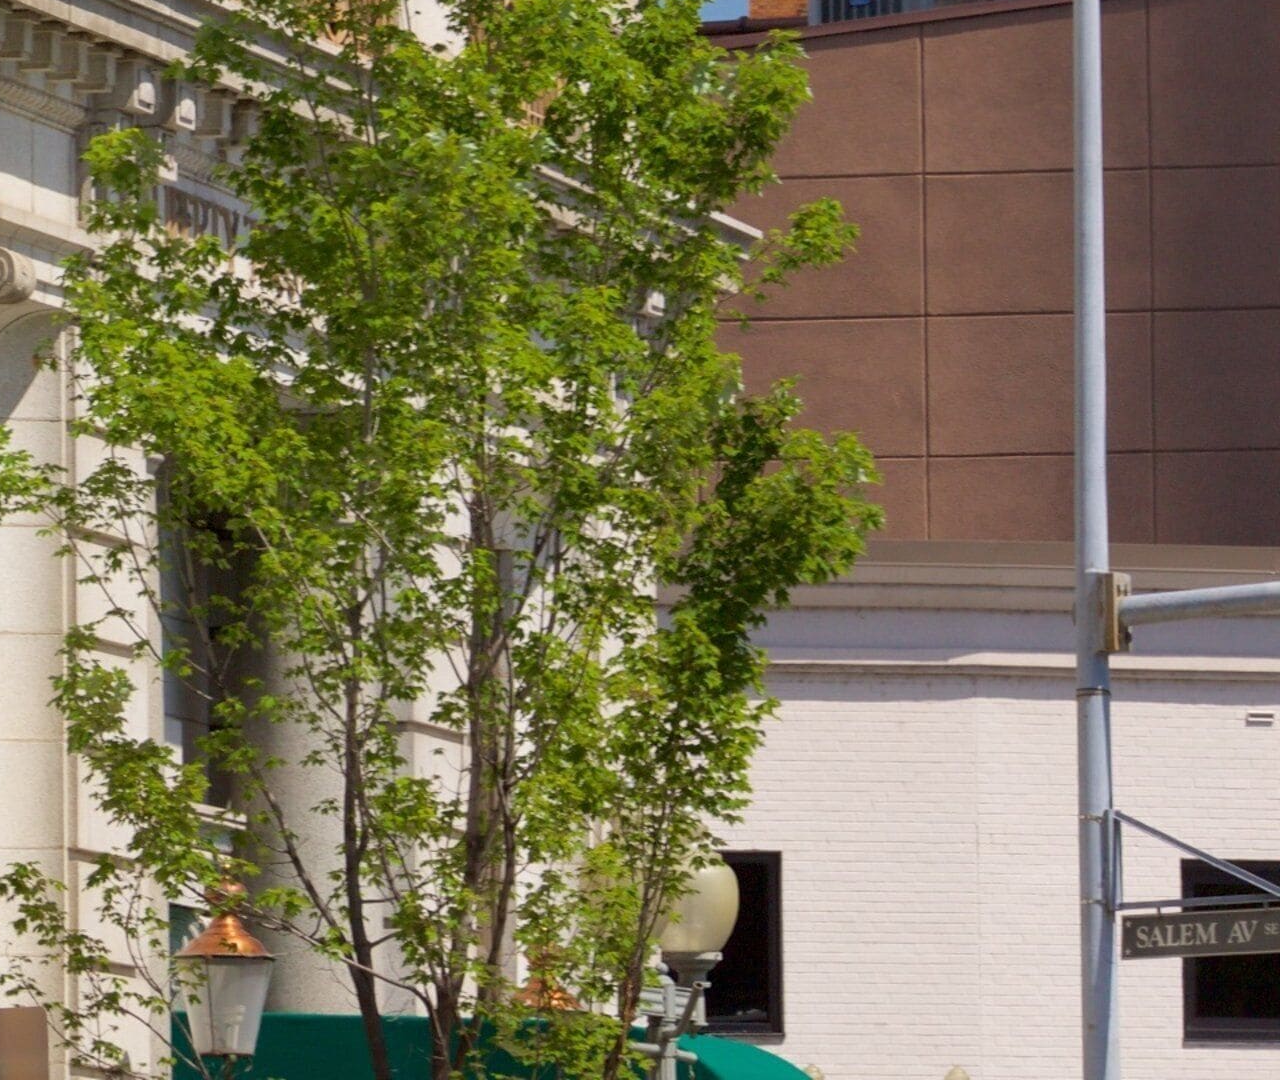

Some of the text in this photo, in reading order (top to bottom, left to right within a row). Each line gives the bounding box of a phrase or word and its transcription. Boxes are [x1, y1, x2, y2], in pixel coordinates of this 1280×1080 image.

[1135, 919, 1280, 949] SALEM AV SE
